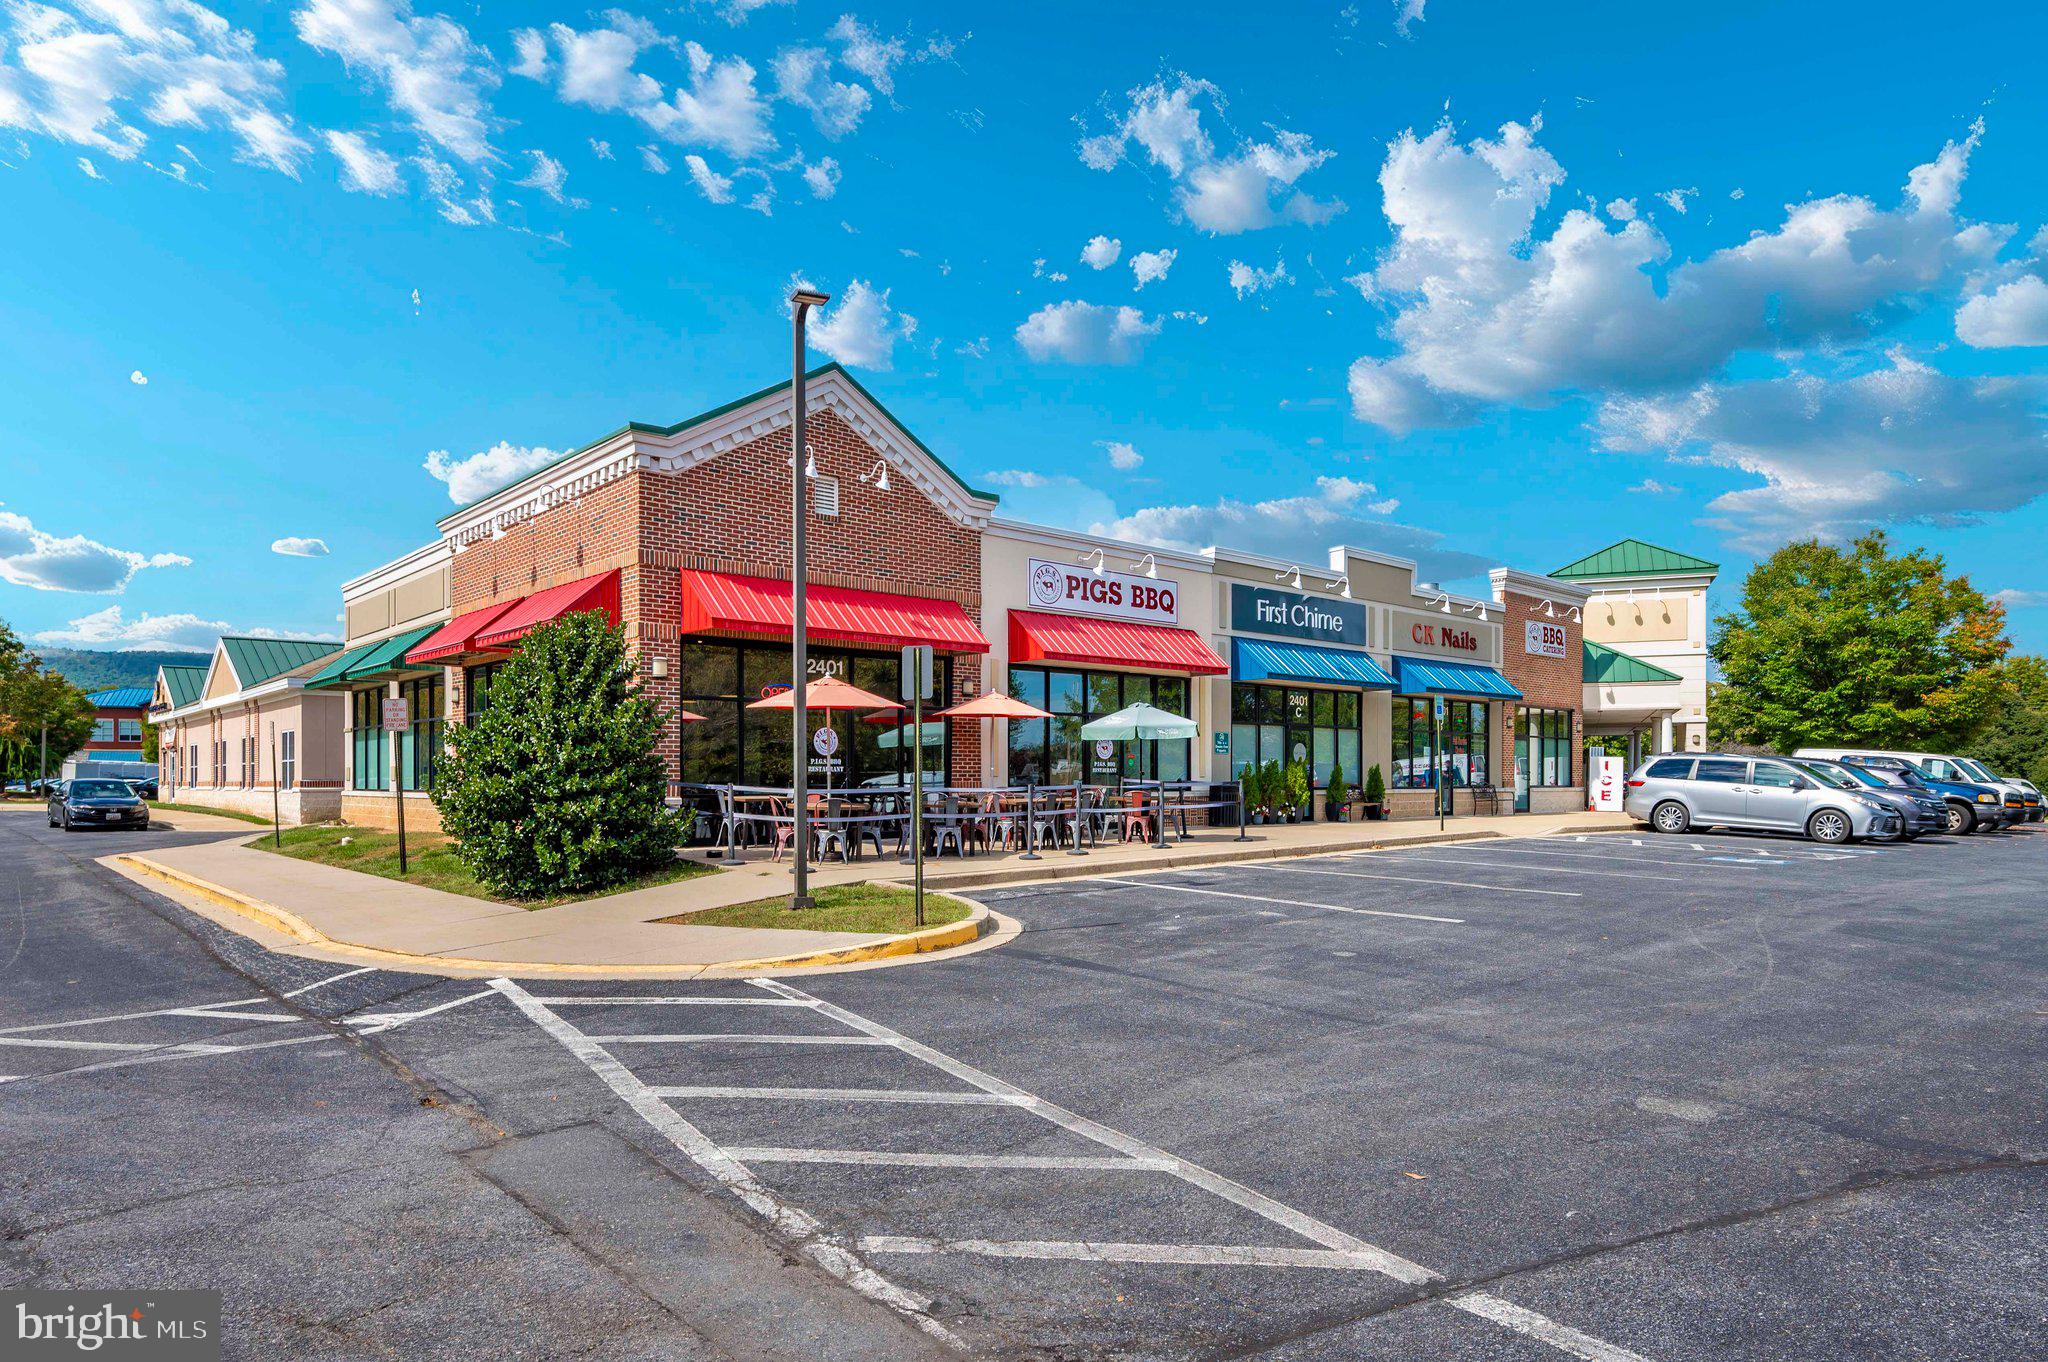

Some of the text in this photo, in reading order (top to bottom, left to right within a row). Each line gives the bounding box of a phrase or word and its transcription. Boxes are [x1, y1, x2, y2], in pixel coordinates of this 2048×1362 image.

[1065, 574, 1123, 606] PIGS
[1130, 584, 1175, 614] BBQ
[1256, 599, 1343, 632] First Chime
[1411, 623, 1477, 651] CK Nails
[1542, 626, 1564, 646] BBQ
[1542, 645, 1565, 655] CATERING
[806, 658, 843, 675] 2401
[1289, 694, 1308, 706] 2401
[1295, 707, 1302, 718] C
[1601, 761, 1612, 801] ICE
